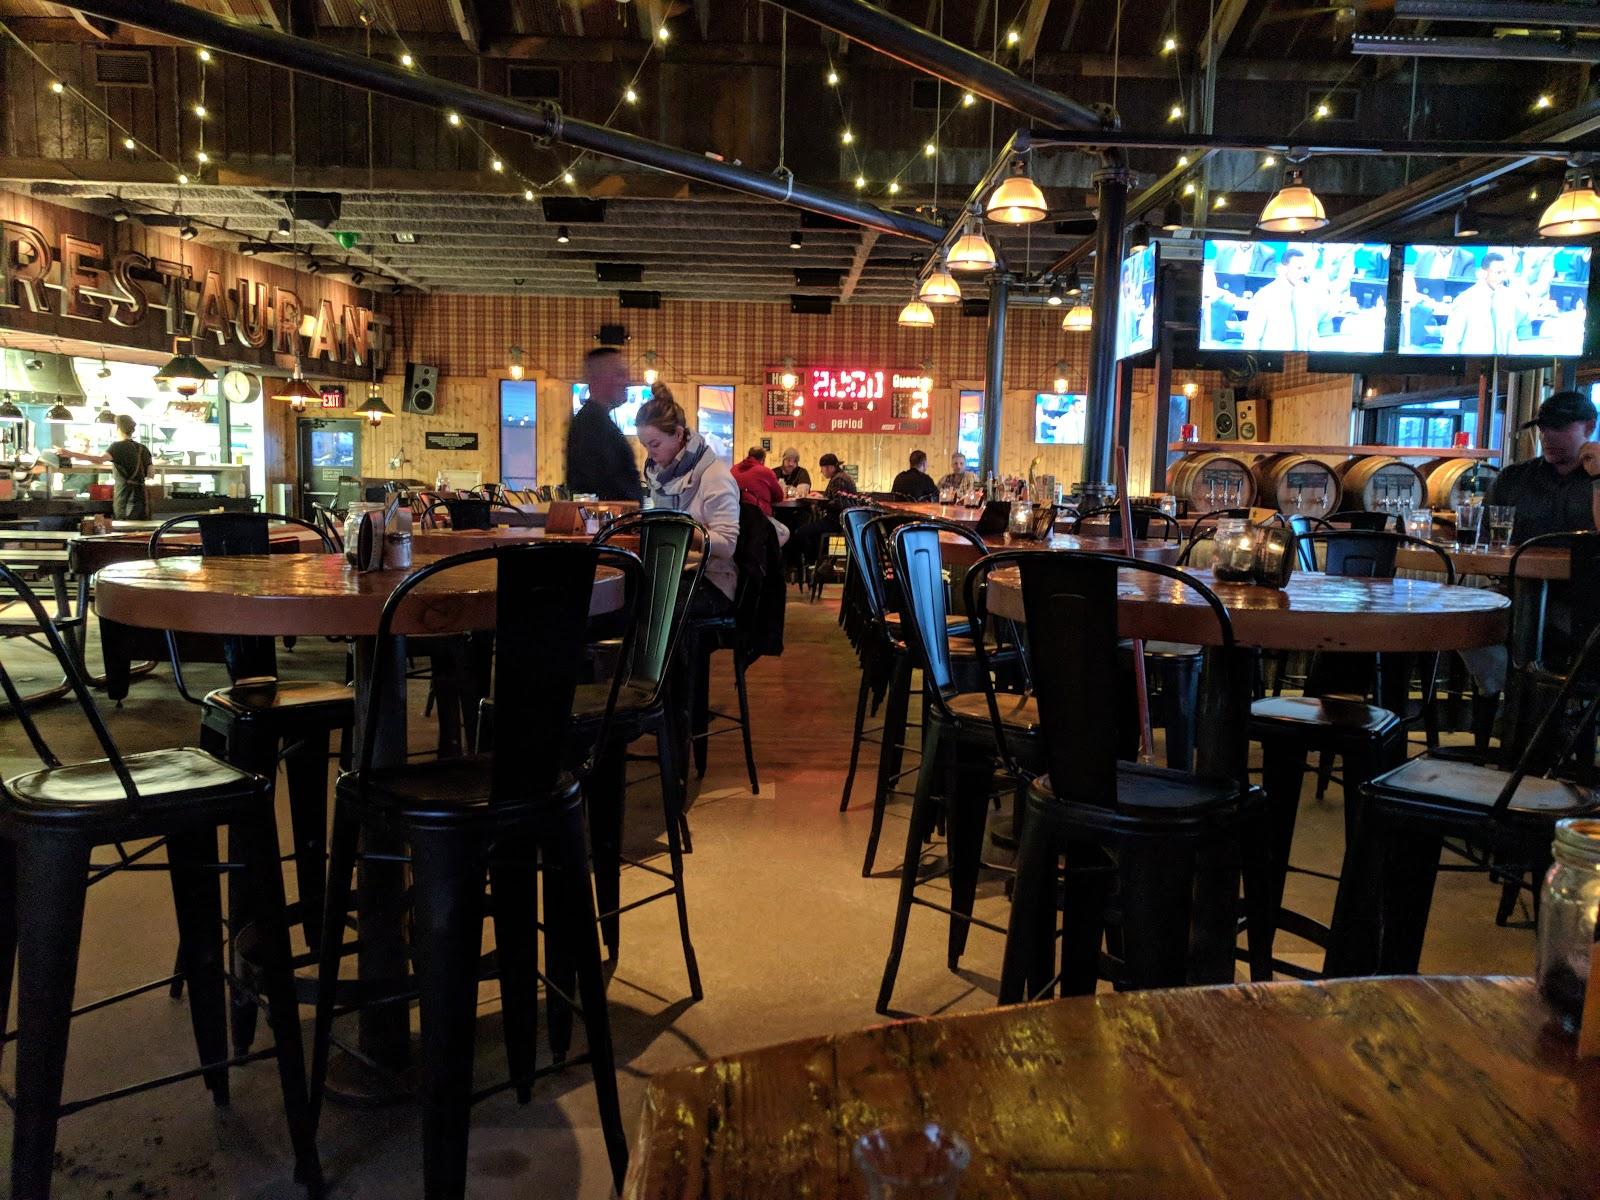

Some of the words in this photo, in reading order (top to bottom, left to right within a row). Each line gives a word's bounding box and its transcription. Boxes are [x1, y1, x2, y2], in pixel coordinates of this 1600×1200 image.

[0, 220, 392, 370] RESTAURANT
[323, 395, 339, 407] EXIT
[838, 401, 843, 410] 2
[853, 401, 858, 411] 3
[867, 401, 874, 411] 4
[831, 417, 863, 431] period
